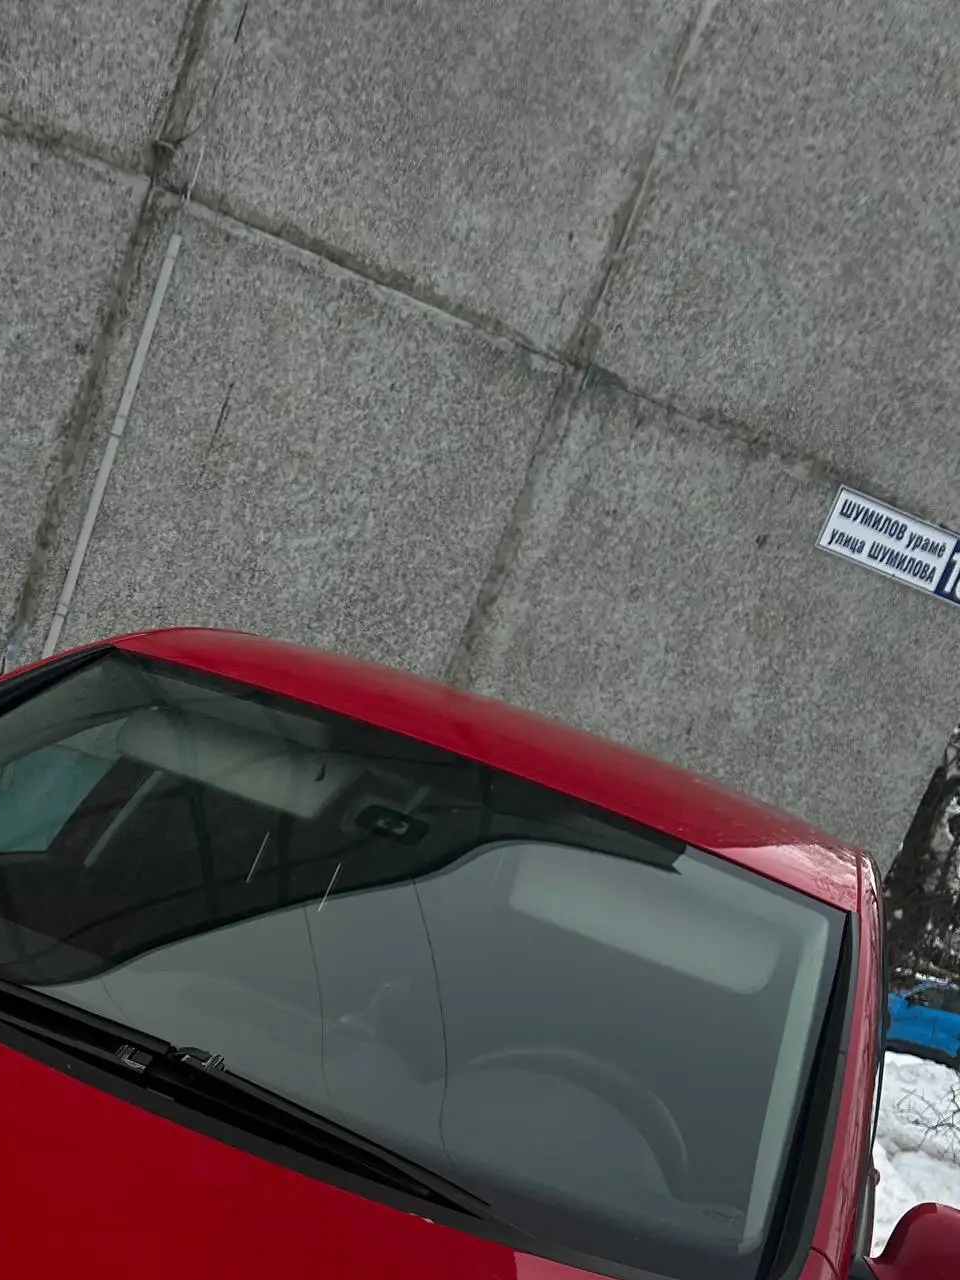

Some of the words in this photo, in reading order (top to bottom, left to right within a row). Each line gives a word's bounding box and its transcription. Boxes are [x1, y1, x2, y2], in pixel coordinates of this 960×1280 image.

[839, 498, 908, 541] ШУМИЛОВ
[827, 528, 866, 554] улица
[867, 541, 937, 584] ШУМИЛОВА
[943, 552, 960, 602] 1
